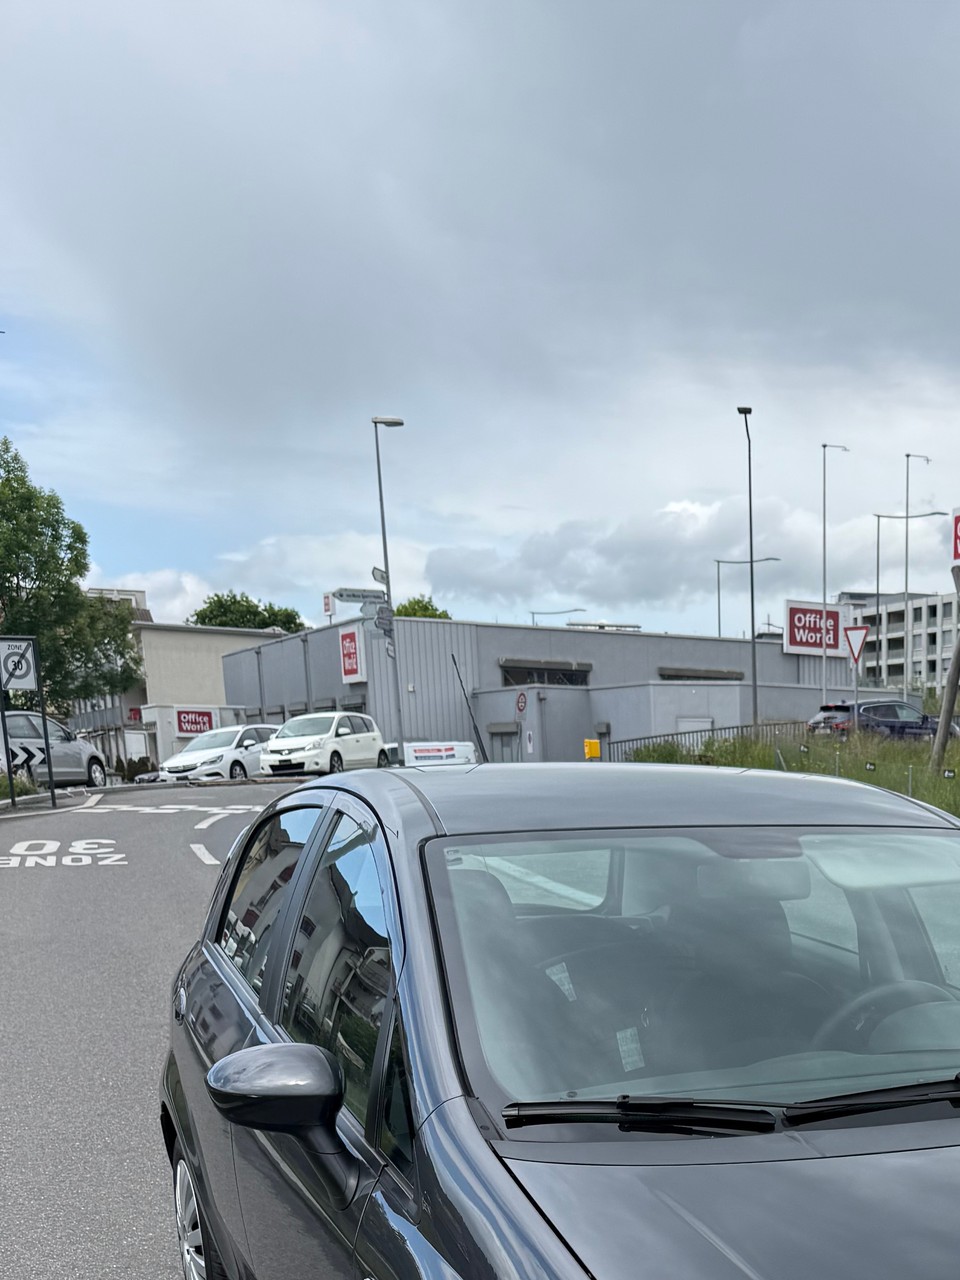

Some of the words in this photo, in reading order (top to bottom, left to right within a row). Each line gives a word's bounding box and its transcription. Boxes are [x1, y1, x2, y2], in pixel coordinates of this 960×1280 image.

[794, 628, 835, 645] Word
[11, 660, 23, 671] 30
[181, 713, 209, 723] Office
[181, 722, 210, 731] World
[9, 839, 117, 855] 30
